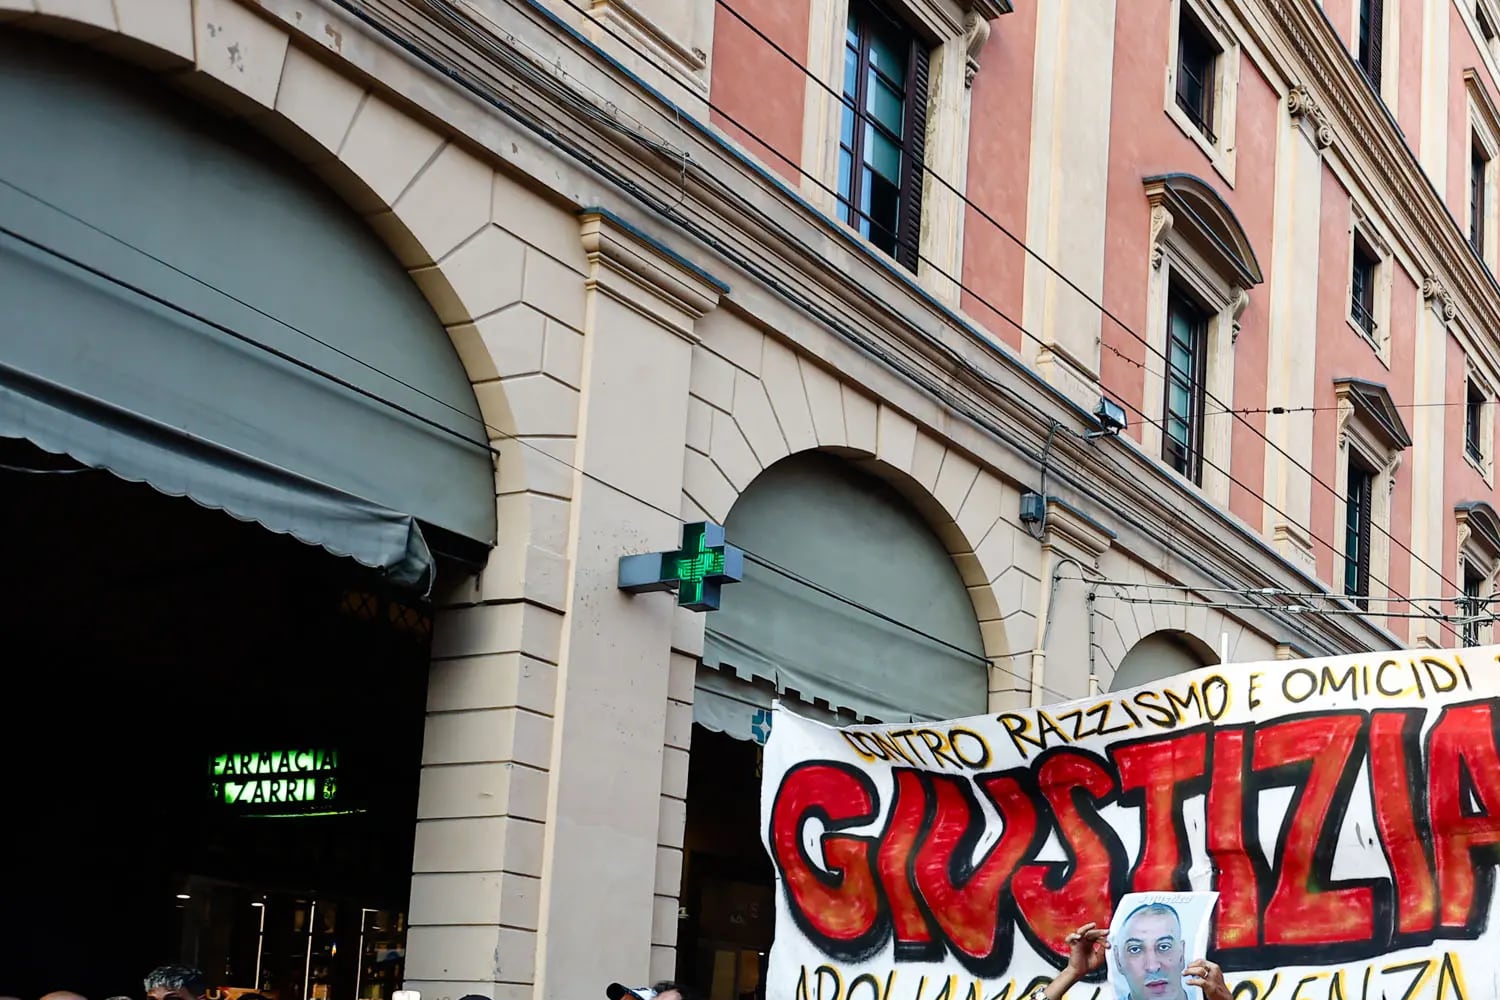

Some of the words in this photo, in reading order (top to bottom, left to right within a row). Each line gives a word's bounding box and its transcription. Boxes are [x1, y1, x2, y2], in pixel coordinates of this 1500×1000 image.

[840, 726, 993, 771] CONTRO
[996, 675, 1232, 759] RAZZISMO
[1249, 672, 1264, 711] E
[1282, 655, 1473, 704] OMICIDI
[211, 750, 338, 775] FARMACIA
[230, 778, 310, 804] ZARRI
